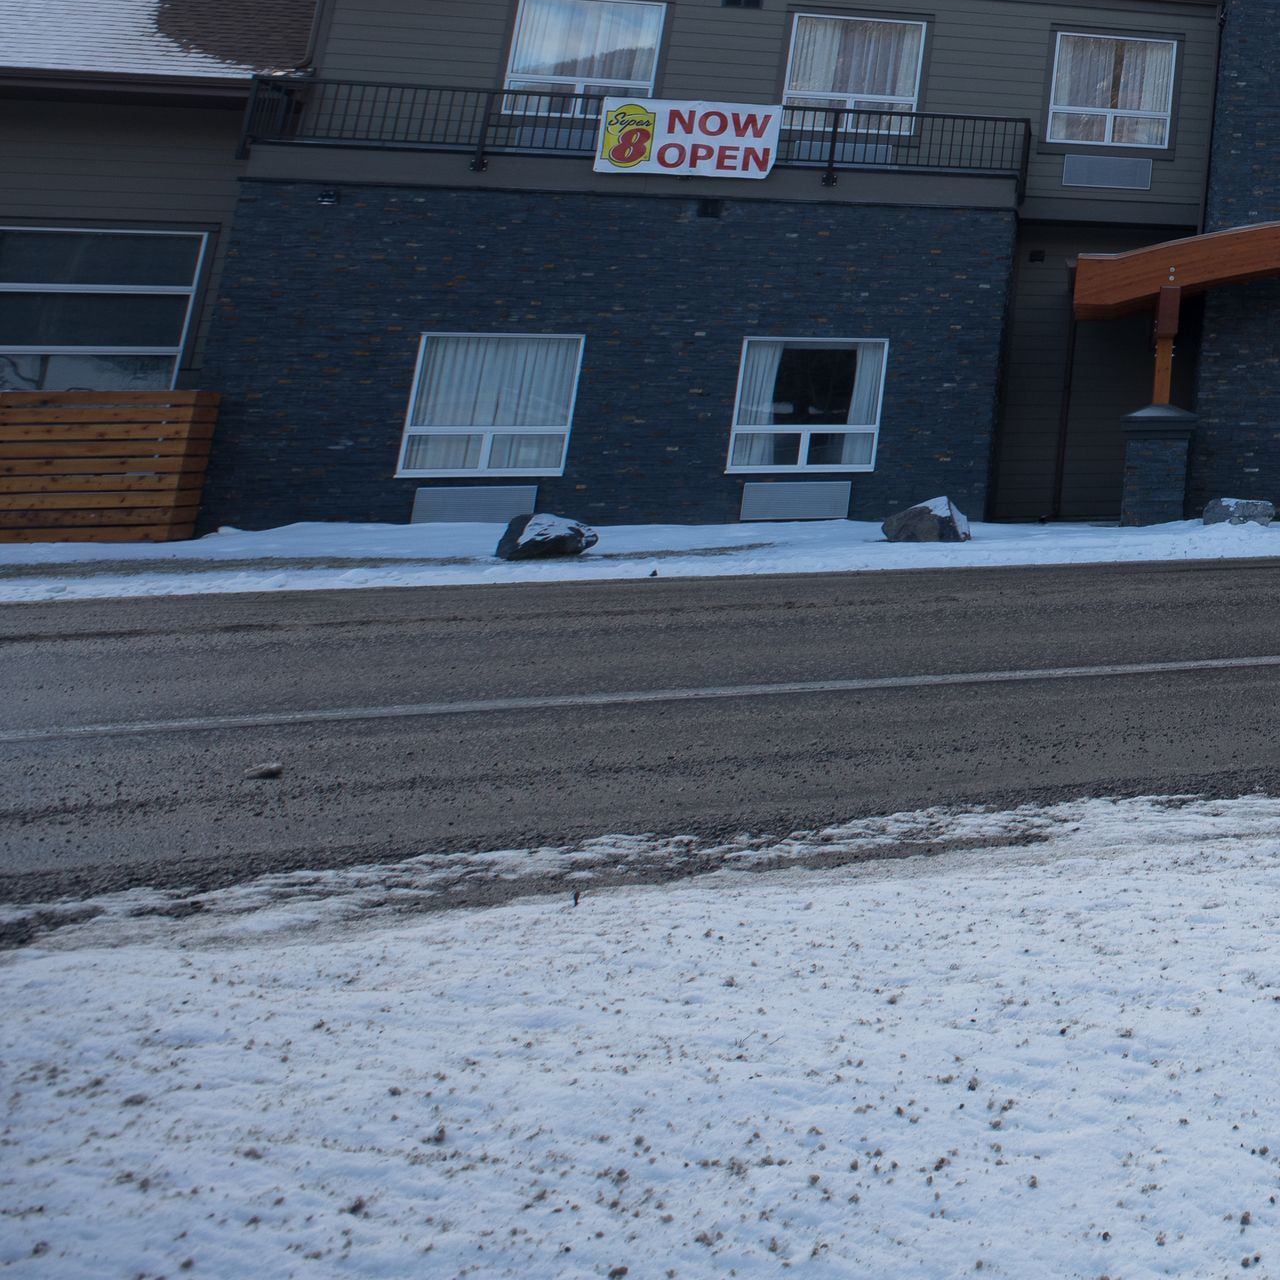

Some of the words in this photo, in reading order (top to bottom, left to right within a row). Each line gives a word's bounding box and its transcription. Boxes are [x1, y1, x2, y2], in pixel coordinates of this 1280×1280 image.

[608, 113, 652, 133] Super
[667, 109, 772, 138] NOW
[609, 128, 651, 164] 8
[656, 143, 770, 172] OPEN
